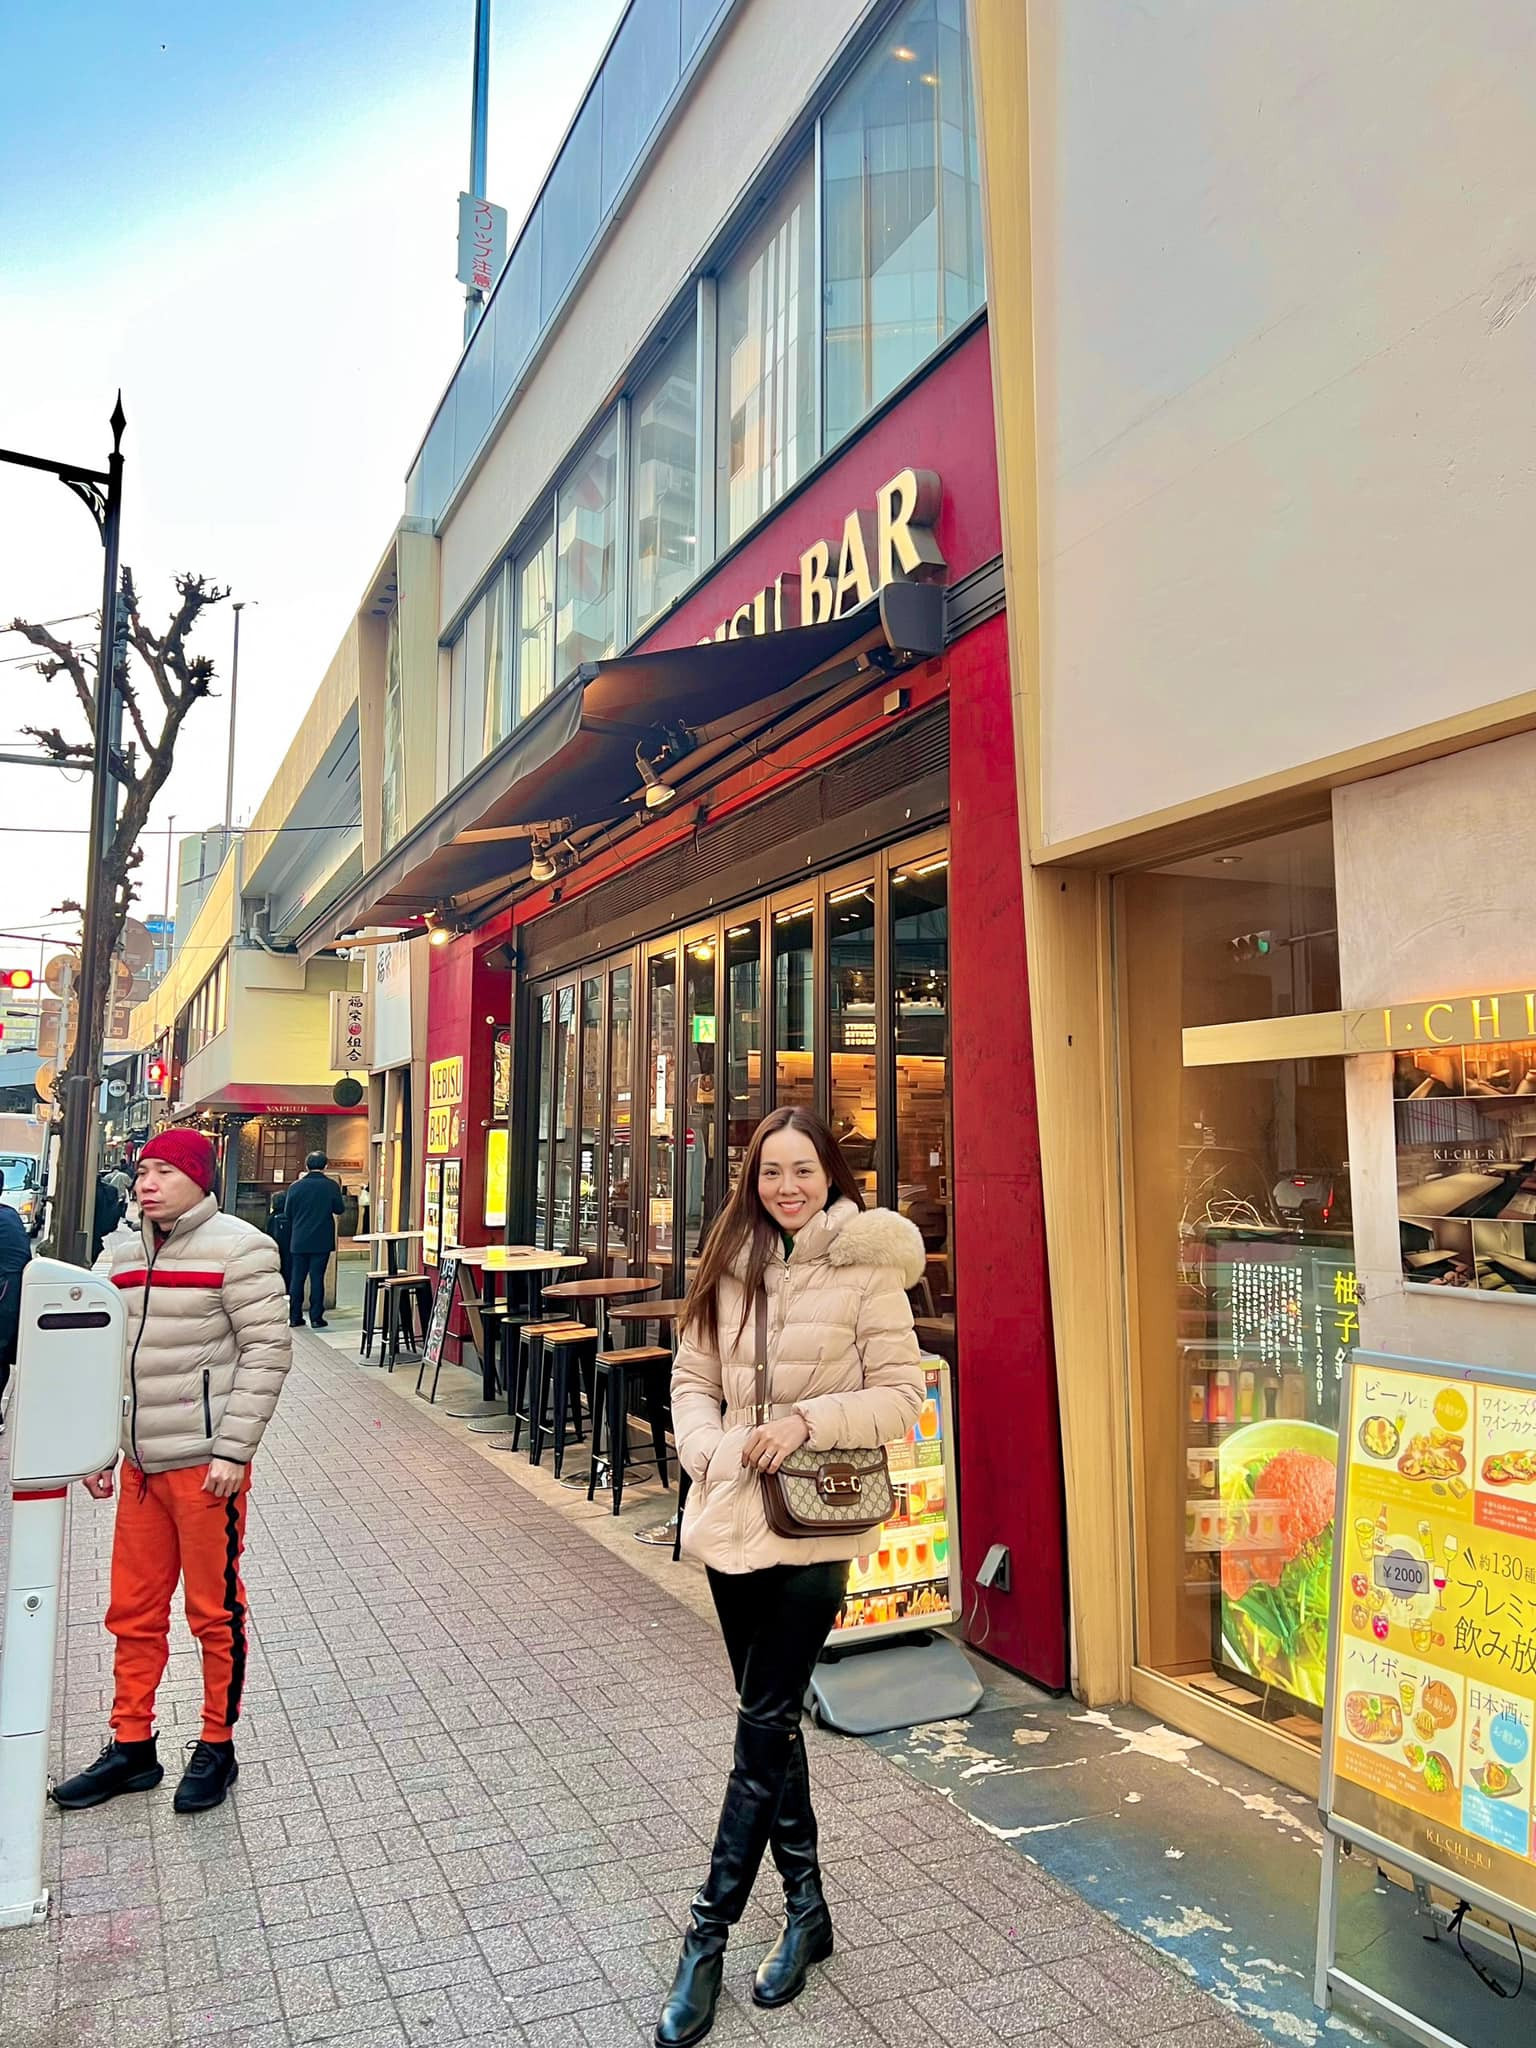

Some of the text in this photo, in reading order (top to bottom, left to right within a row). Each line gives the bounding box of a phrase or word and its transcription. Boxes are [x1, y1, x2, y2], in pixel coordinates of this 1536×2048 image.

[472, 200, 493, 290] スリップ注意
[800, 468, 922, 627] BAR
[431, 1063, 462, 1101] YEBISU
[266, 1105, 308, 1113] VAPEUR
[429, 1114, 448, 1146] BAR
[1365, 1381, 1429, 1409] ビールに
[1458, 1579, 1536, 1633] プレミ
[1453, 1615, 1536, 1676] 飲み放
[1349, 1650, 1449, 1698] ハイボールに
[1470, 1688, 1531, 1727] 日本酒に
